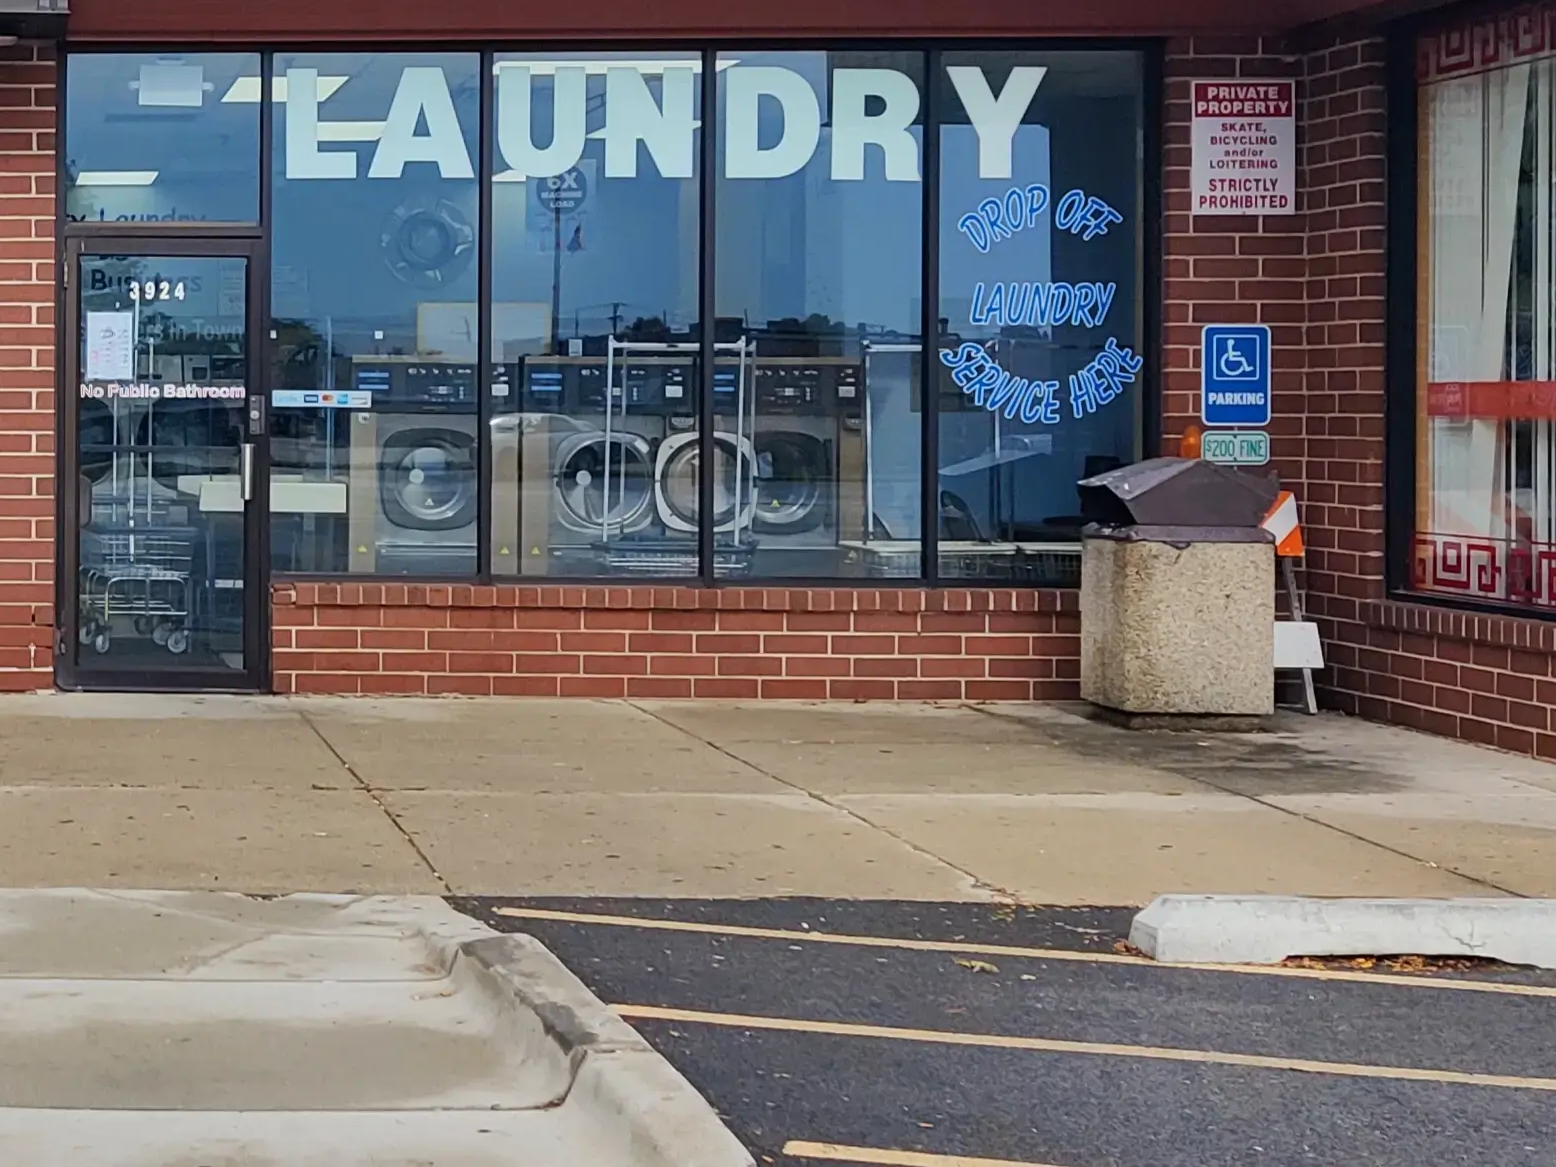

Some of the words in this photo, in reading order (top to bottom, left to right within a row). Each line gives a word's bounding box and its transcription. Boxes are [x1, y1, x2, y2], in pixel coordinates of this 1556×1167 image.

[1207, 86, 1279, 99] PRIVATE
[1197, 101, 1288, 114] PROPERTY
[285, 66, 1047, 180] LAUNDRY
[1221, 122, 1267, 133] SKATE,
[1210, 136, 1278, 145] BICYCLING
[1224, 148, 1264, 157] and/or
[1210, 160, 1278, 169] LOITERING
[1209, 178, 1278, 192] STRICTLY
[1199, 195, 1288, 208] PROHIBITED
[958, 183, 1049, 253] DROP
[1055, 189, 1123, 241] OFF
[129, 281, 186, 300] 3924
[970, 282, 1116, 327] LAUNDRY
[939, 342, 1060, 423] SERVICE
[1069, 337, 1143, 418] HERE
[80, 384, 104, 399] No
[108, 384, 160, 399] Public
[163, 384, 246, 399] Bathroom
[1208, 392, 1265, 405] PARKING
[1206, 440, 1235, 457] $200
[1240, 440, 1265, 457] FINE
